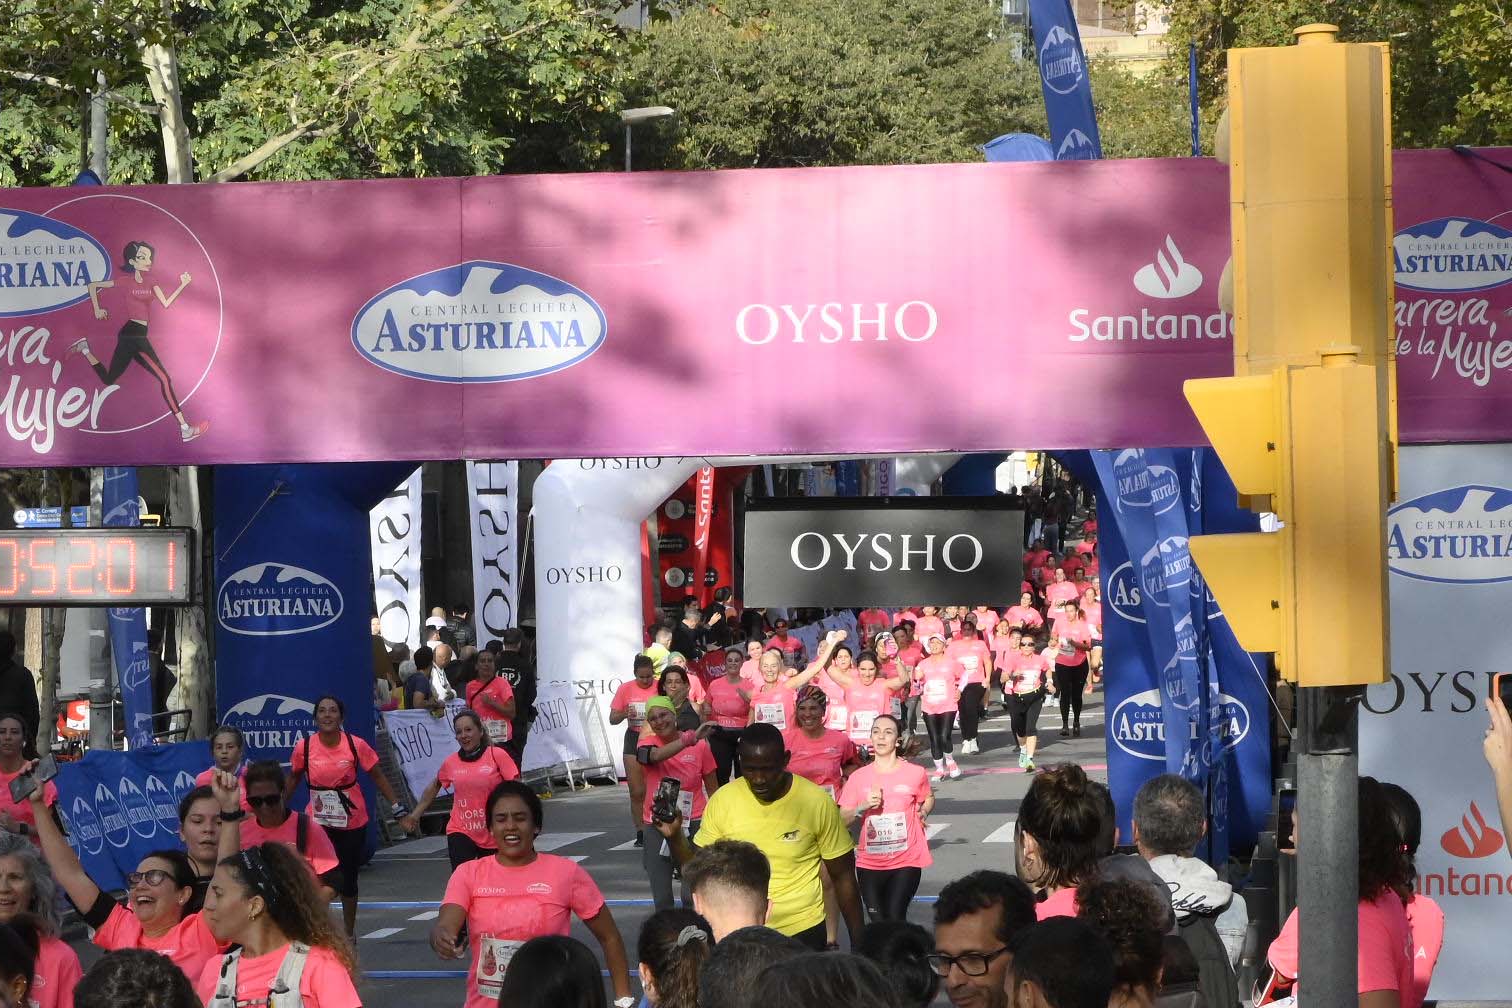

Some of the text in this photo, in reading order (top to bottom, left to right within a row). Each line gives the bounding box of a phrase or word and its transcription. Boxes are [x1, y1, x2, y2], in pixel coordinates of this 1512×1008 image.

[14, 245, 86, 256] LECHERA
[1408, 242, 1459, 250] CENTRAL
[411, 302, 577, 316] CENTRAL LECHERA
[372, 307, 587, 353] ASTURIANA
[736, 301, 938, 344] OYSHO
[1418, 329, 1435, 355] la
[1415, 520, 1482, 530] CENTRAL
[791, 531, 983, 572] OYSHO
[546, 565, 622, 585] OYSHO
[281, 587, 330, 595] LECHERA
[221, 591, 335, 620] ASTURIANA
